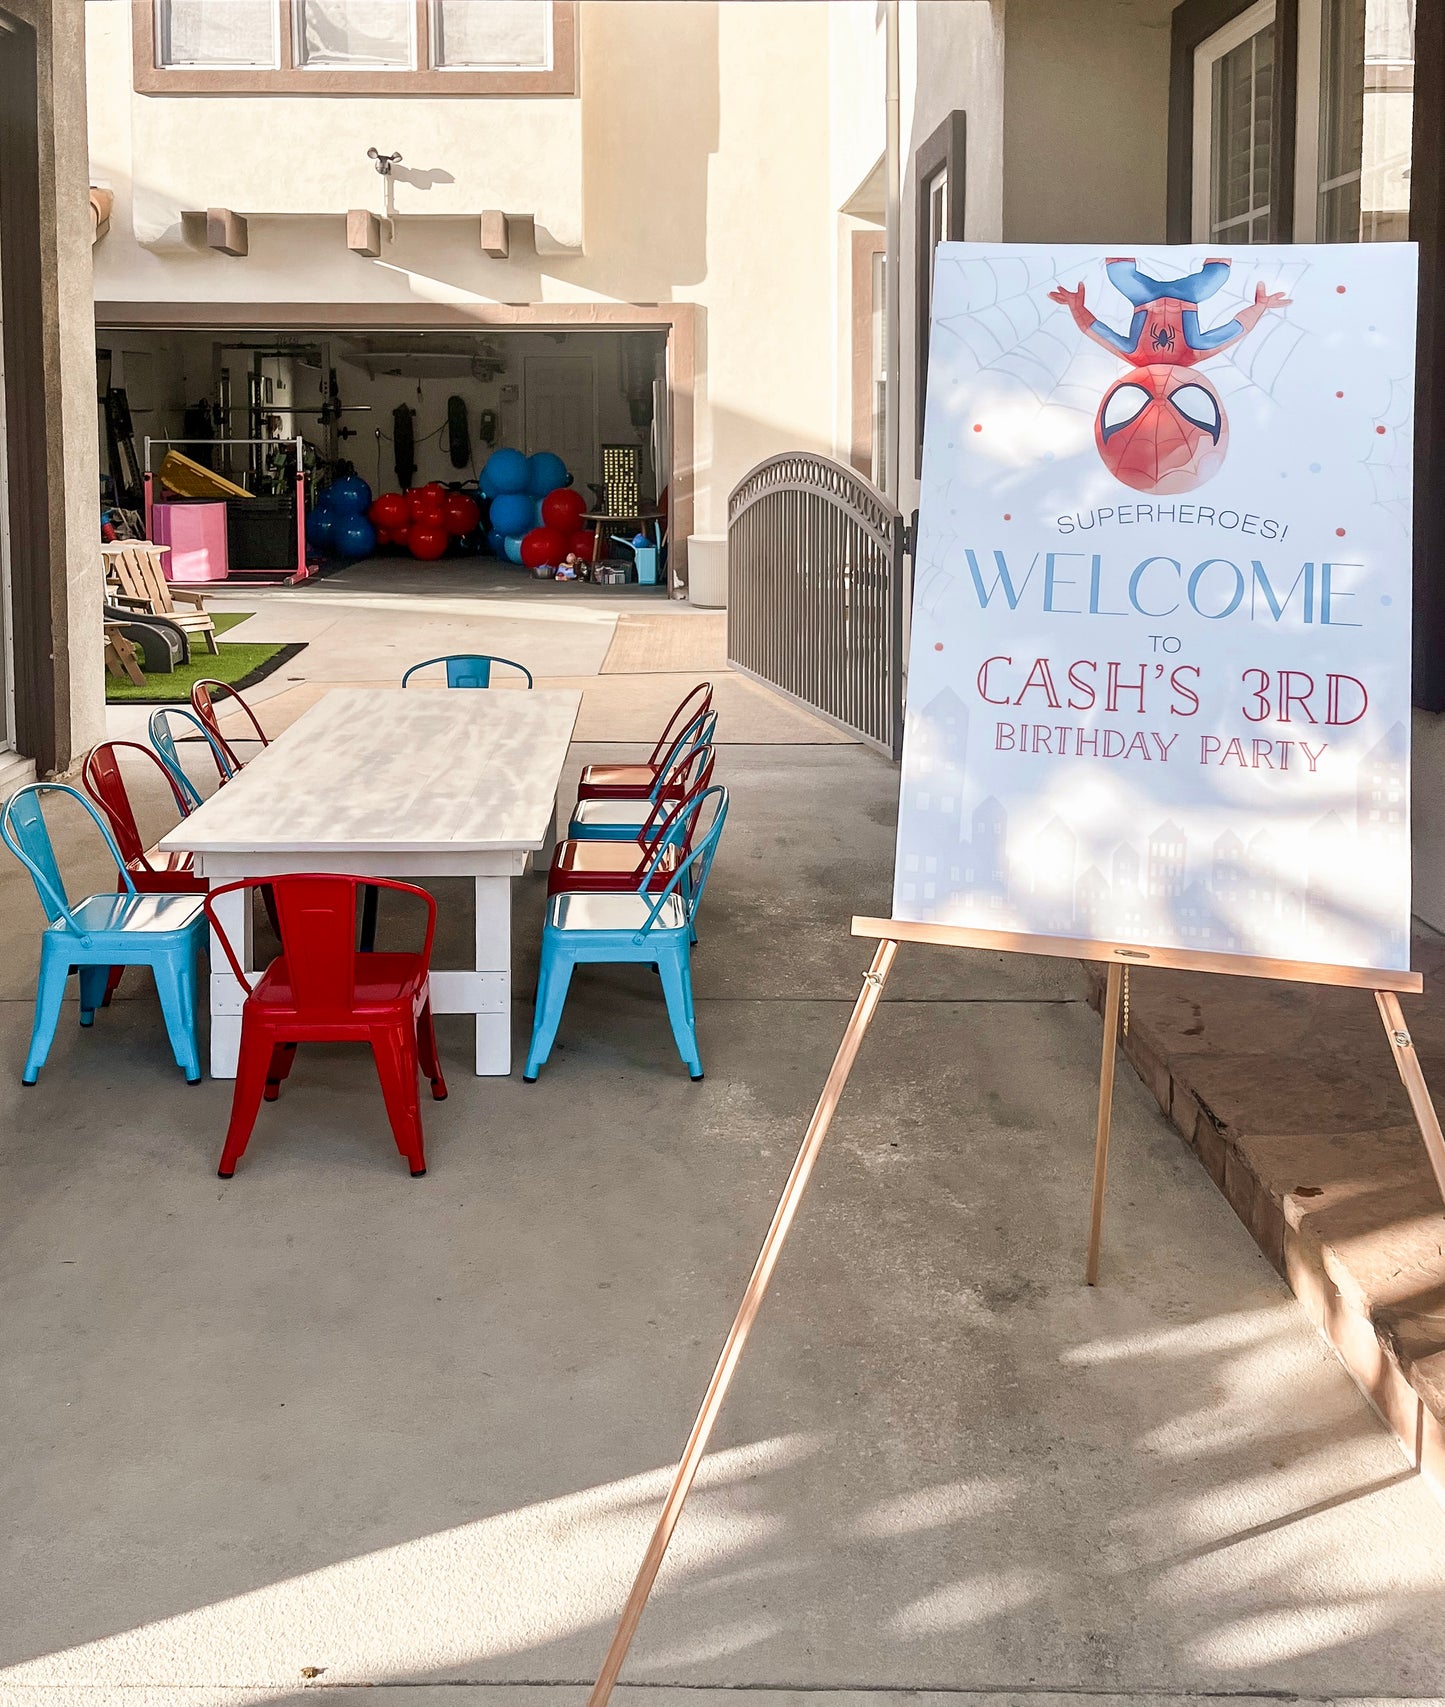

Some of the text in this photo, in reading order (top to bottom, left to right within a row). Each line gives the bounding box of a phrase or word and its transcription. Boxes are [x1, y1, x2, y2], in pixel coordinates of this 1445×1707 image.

[1057, 504, 1289, 542] SUPERHEROES!
[964, 549, 1364, 626] WELCOME
[1148, 635, 1182, 654] TO
[977, 656, 1369, 726] CASH'S 3RD
[994, 722, 1329, 772] BIRTHDAY PARTY
